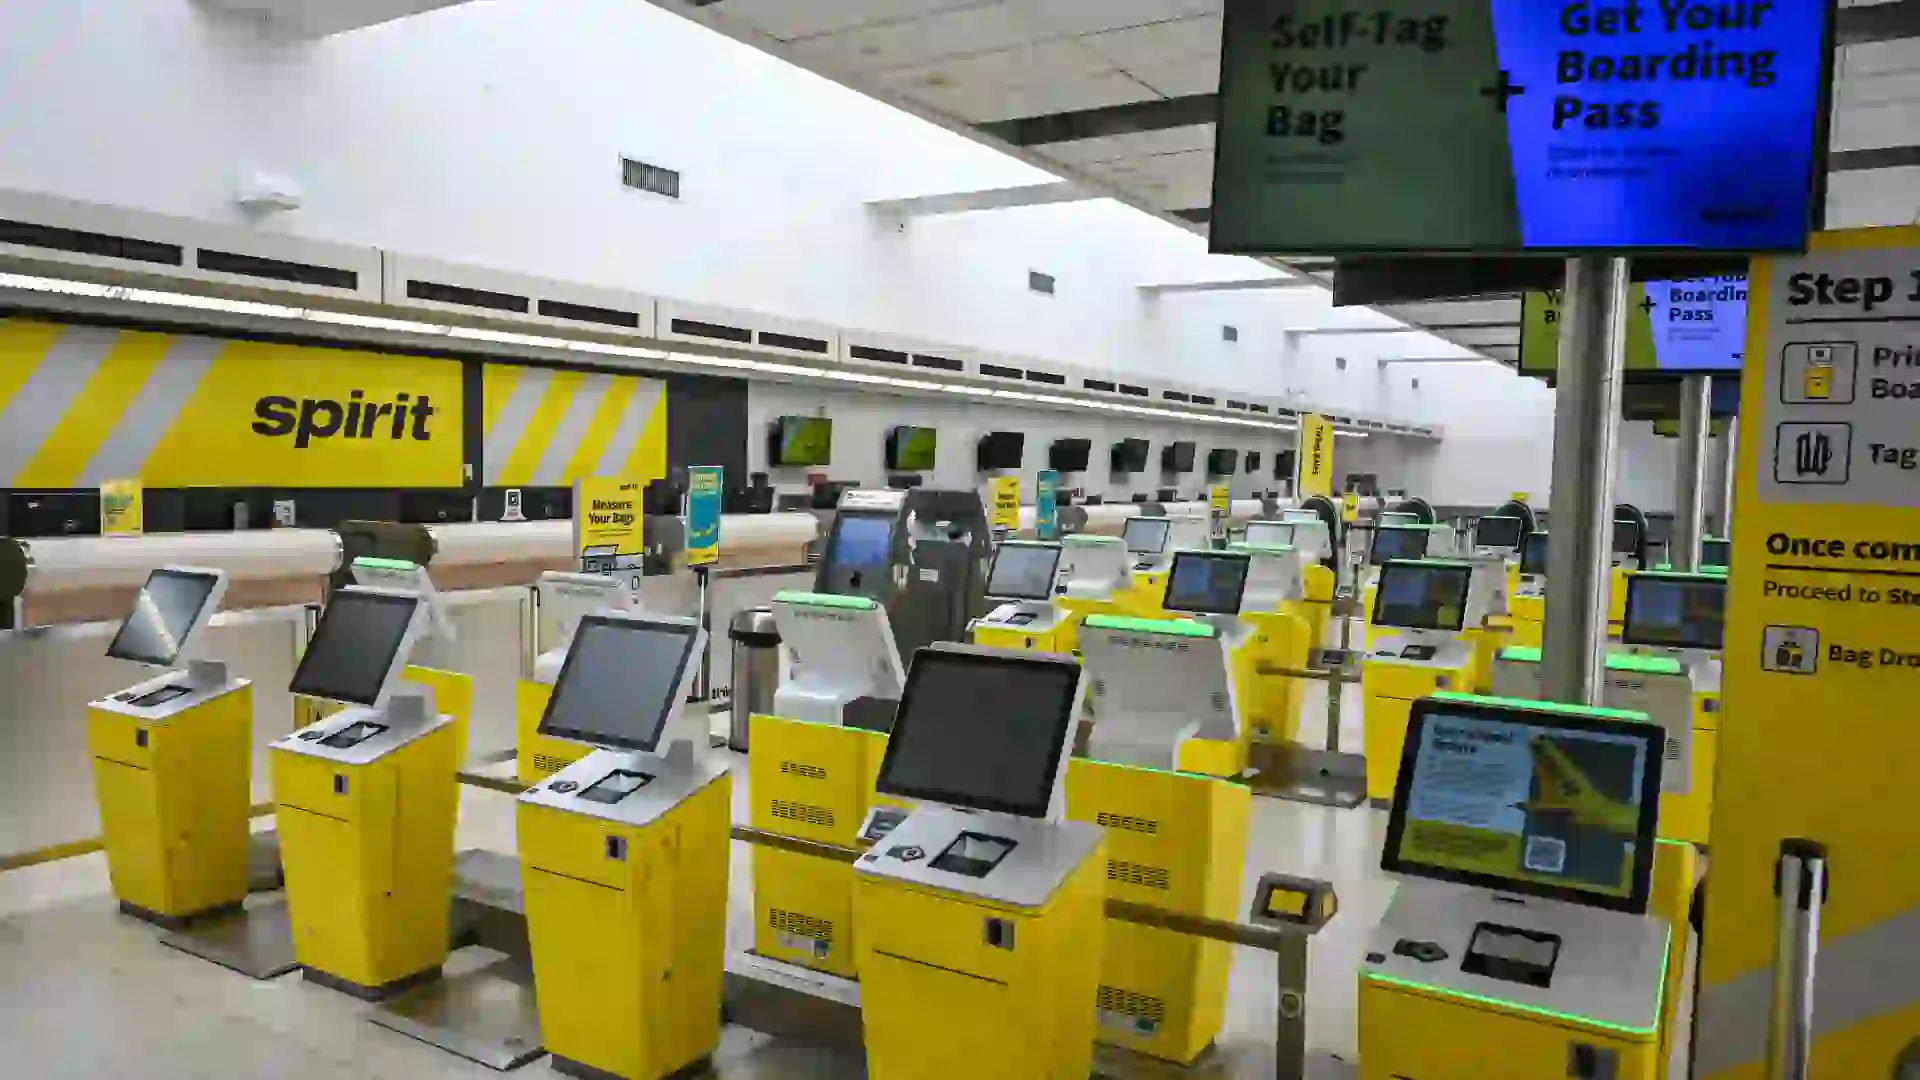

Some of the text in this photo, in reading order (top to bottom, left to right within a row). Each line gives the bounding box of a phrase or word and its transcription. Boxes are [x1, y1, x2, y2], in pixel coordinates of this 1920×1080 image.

[1270, 11, 1449, 51] Self-Tag
[1559, 0, 1774, 35] Get Your
[1269, 63, 1368, 94] Your
[1557, 42, 1778, 88] Boarding
[1266, 104, 1345, 144] Bag
[1553, 96, 1661, 130] Pass
[1787, 272, 1893, 311] Step
[1669, 307, 1713, 322] Pass
[252, 389, 434, 449] spirit
[1867, 442, 1919, 470] Tag
[588, 511, 611, 525] Your
[592, 499, 633, 510] Measure
[1765, 532, 1845, 558] Once
[1763, 580, 1851, 602] Proceed
[1859, 587, 1881, 603] to
[1828, 644, 1874, 669] Bag
